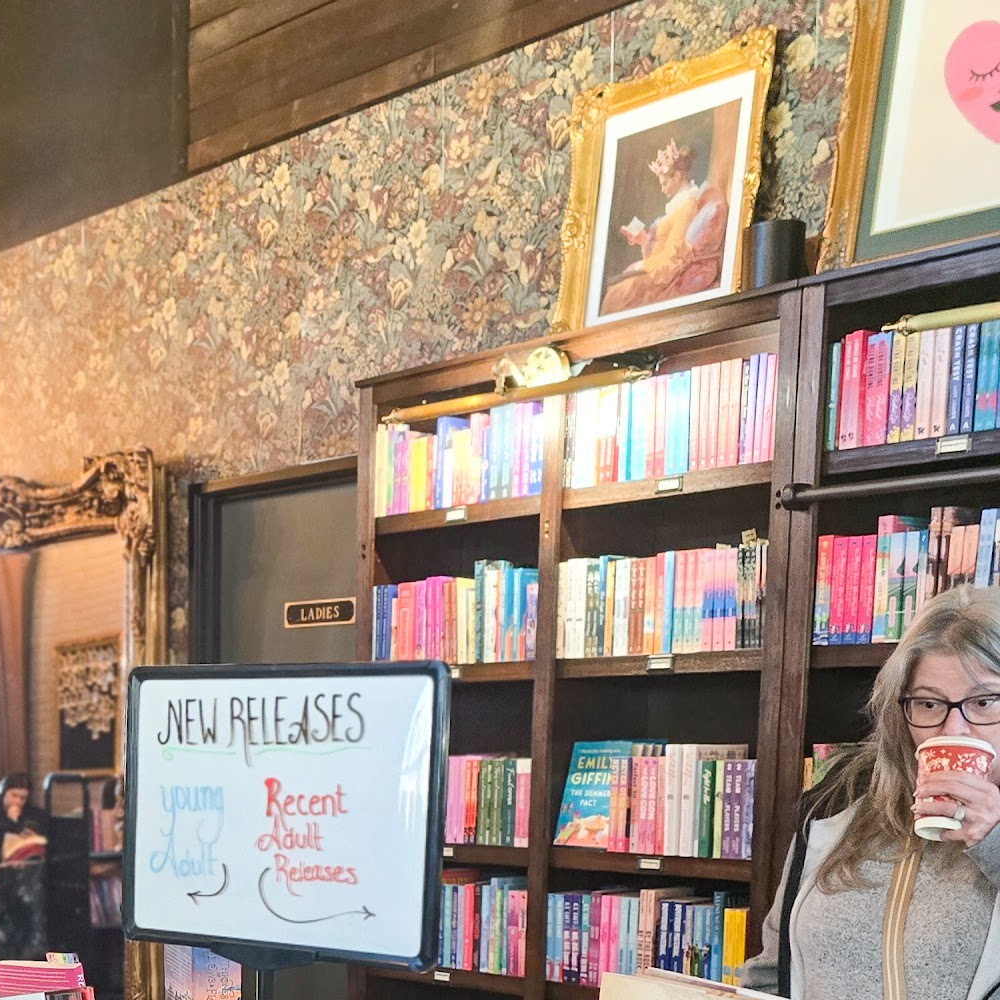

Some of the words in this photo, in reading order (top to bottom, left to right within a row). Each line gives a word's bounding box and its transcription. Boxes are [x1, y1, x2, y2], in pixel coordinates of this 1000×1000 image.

[953, 327, 962, 358] CRASH
[968, 324, 977, 357] CRASH
[952, 360, 960, 381] TEST
[965, 358, 974, 379] TEST
[300, 605, 340, 622] LADIES
[157, 697, 217, 745] NEW
[228, 693, 366, 768] RELEASES
[506, 767, 515, 787] Final
[648, 776, 656, 799] LOVE
[264, 777, 348, 819] Recent
[580, 799, 597, 807] PACT
[161, 783, 225, 846] young
[255, 823, 323, 852] Adult
[150, 833, 216, 878] Adult
[273, 853, 359, 897] Releases
